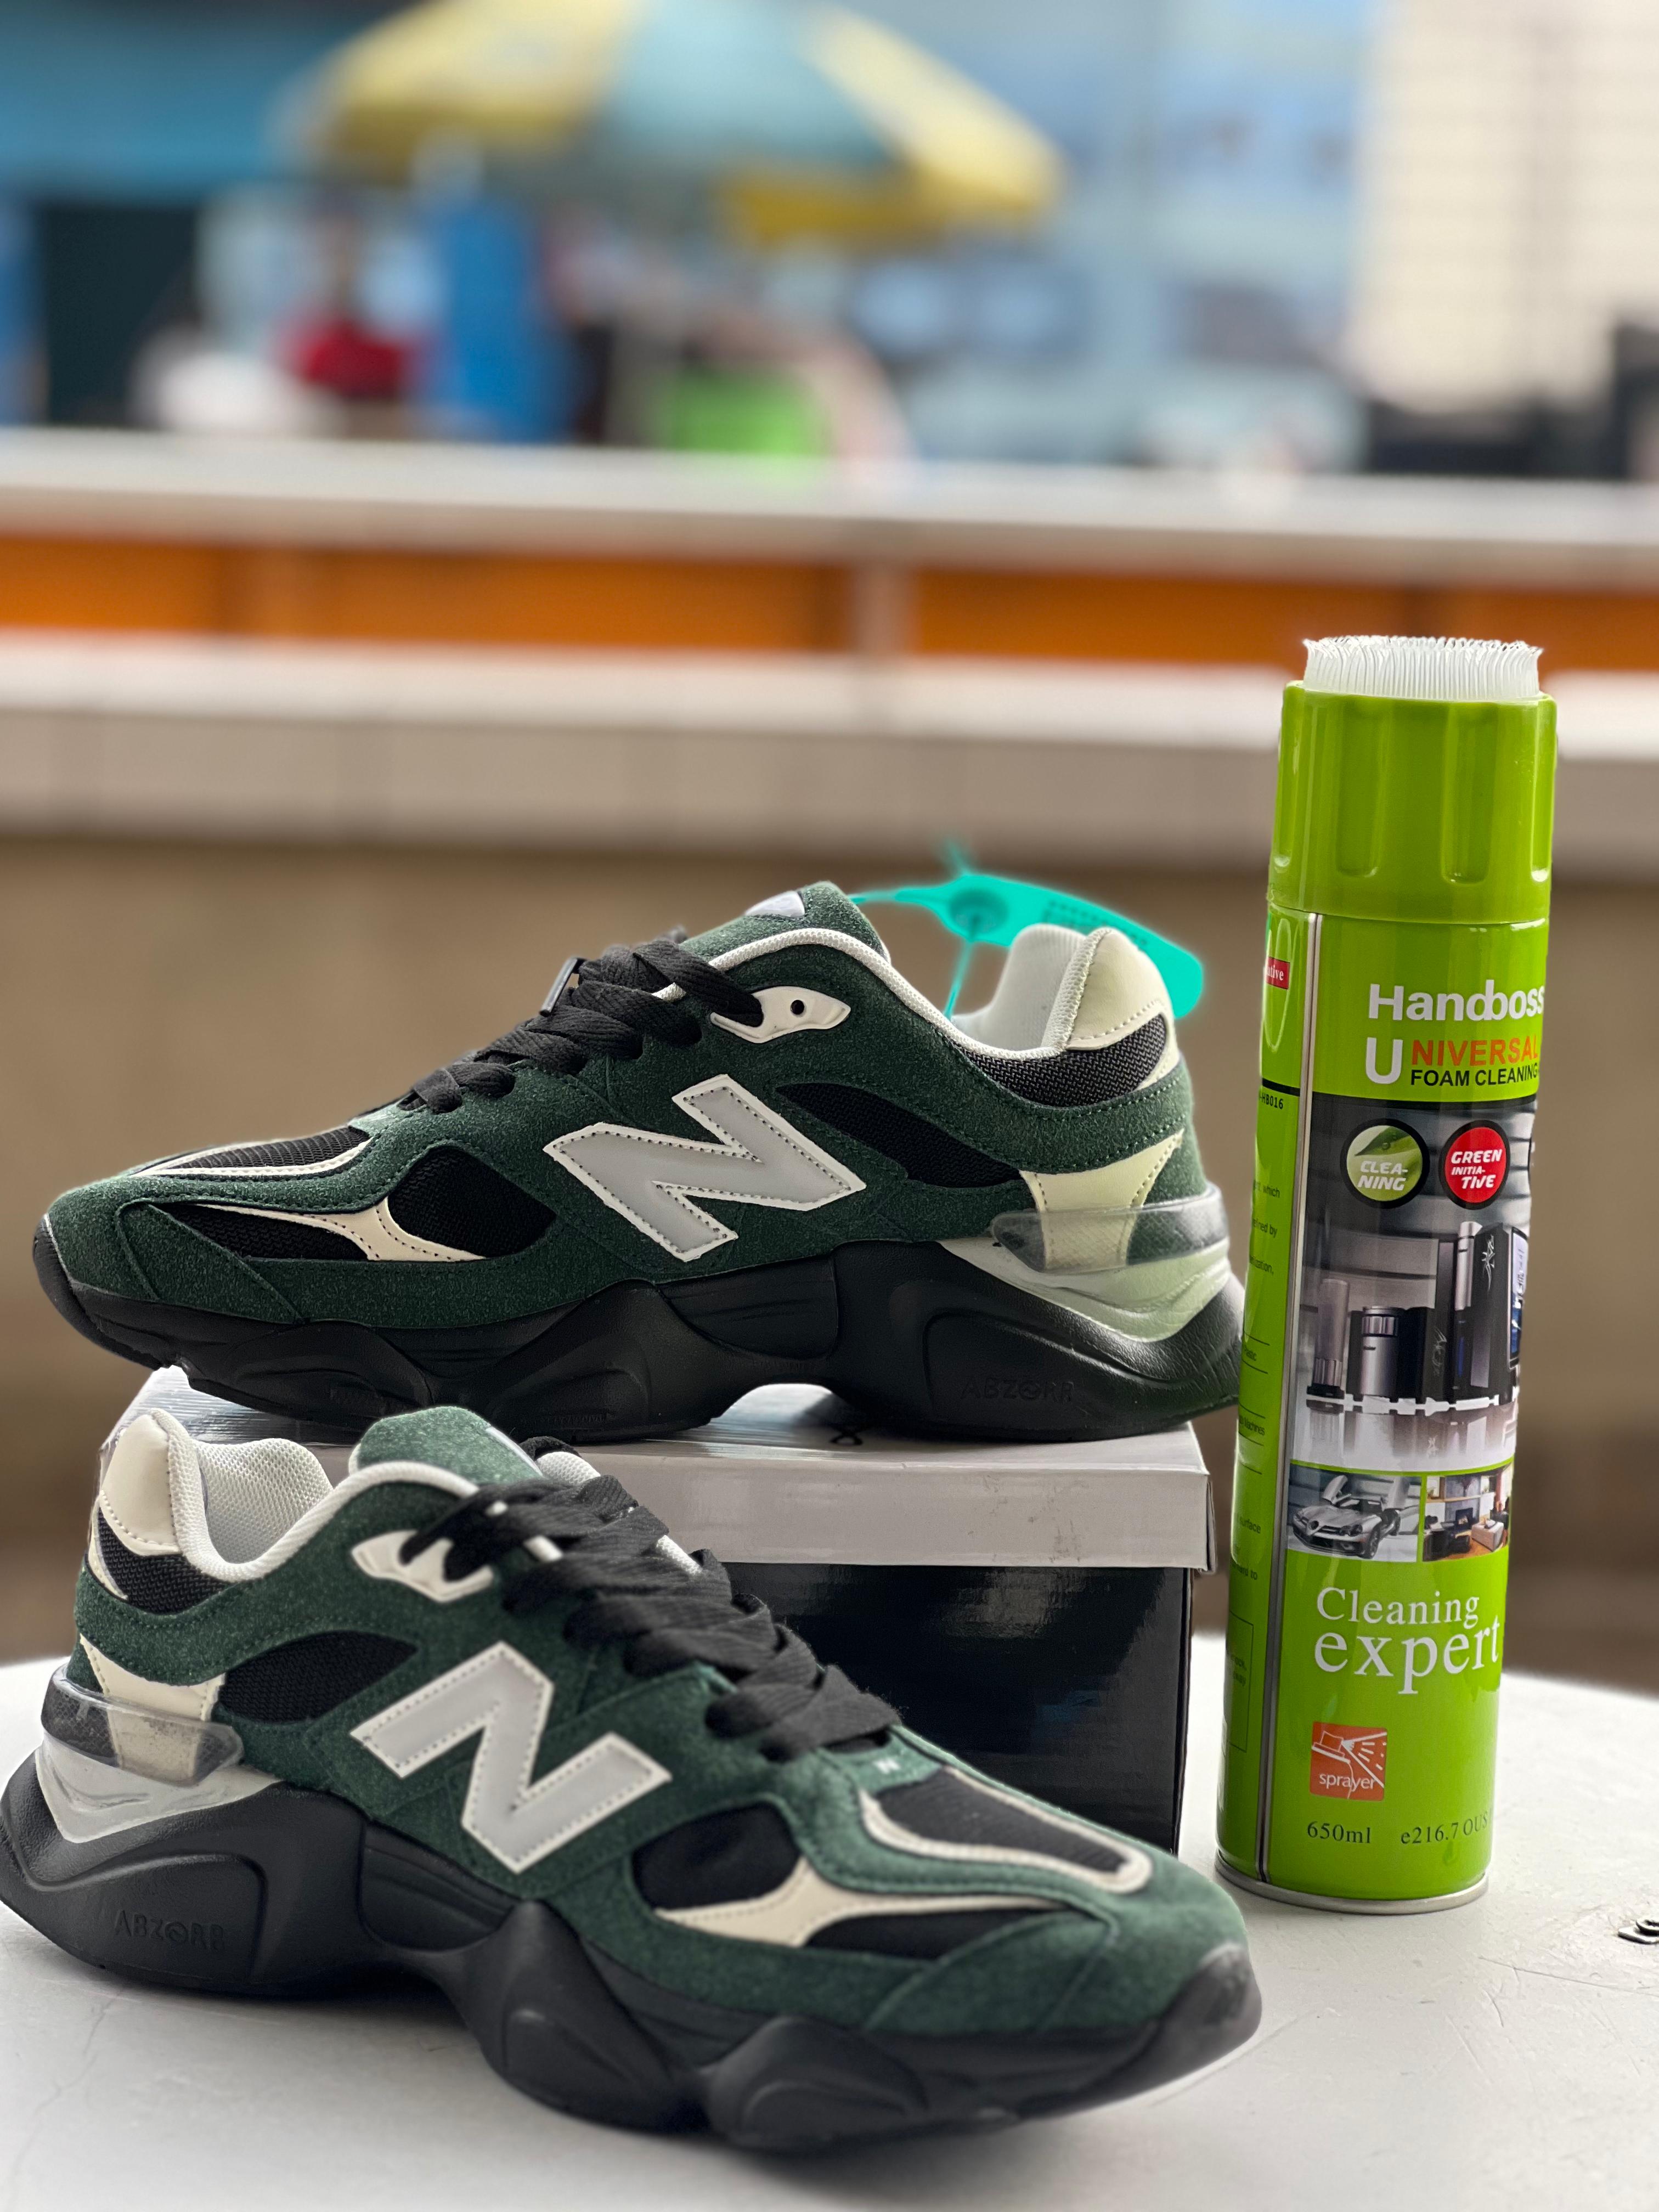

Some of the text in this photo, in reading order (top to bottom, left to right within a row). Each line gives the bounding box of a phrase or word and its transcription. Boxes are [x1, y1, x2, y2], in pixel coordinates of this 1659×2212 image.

[1369, 979, 1544, 1021] Handboss
[1410, 1062, 1538, 1086] FOAM CLEANING
[542, 1073, 867, 1262] N
[1360, 1160, 1409, 1175] CLEA-
[1451, 1148, 1503, 1164] GREEN
[1451, 1165, 1486, 1176] INITIA-
[1460, 1173, 1497, 1189] TIVE
[1357, 1175, 1407, 1191] NING
[1317, 1587, 1480, 1629] Cleaning
[1314, 1615, 1500, 1694] expert
[349, 1640, 673, 1875] N
[1319, 1773, 1375, 1792] sprayer
[1307, 1821, 1371, 1844] 650ml
